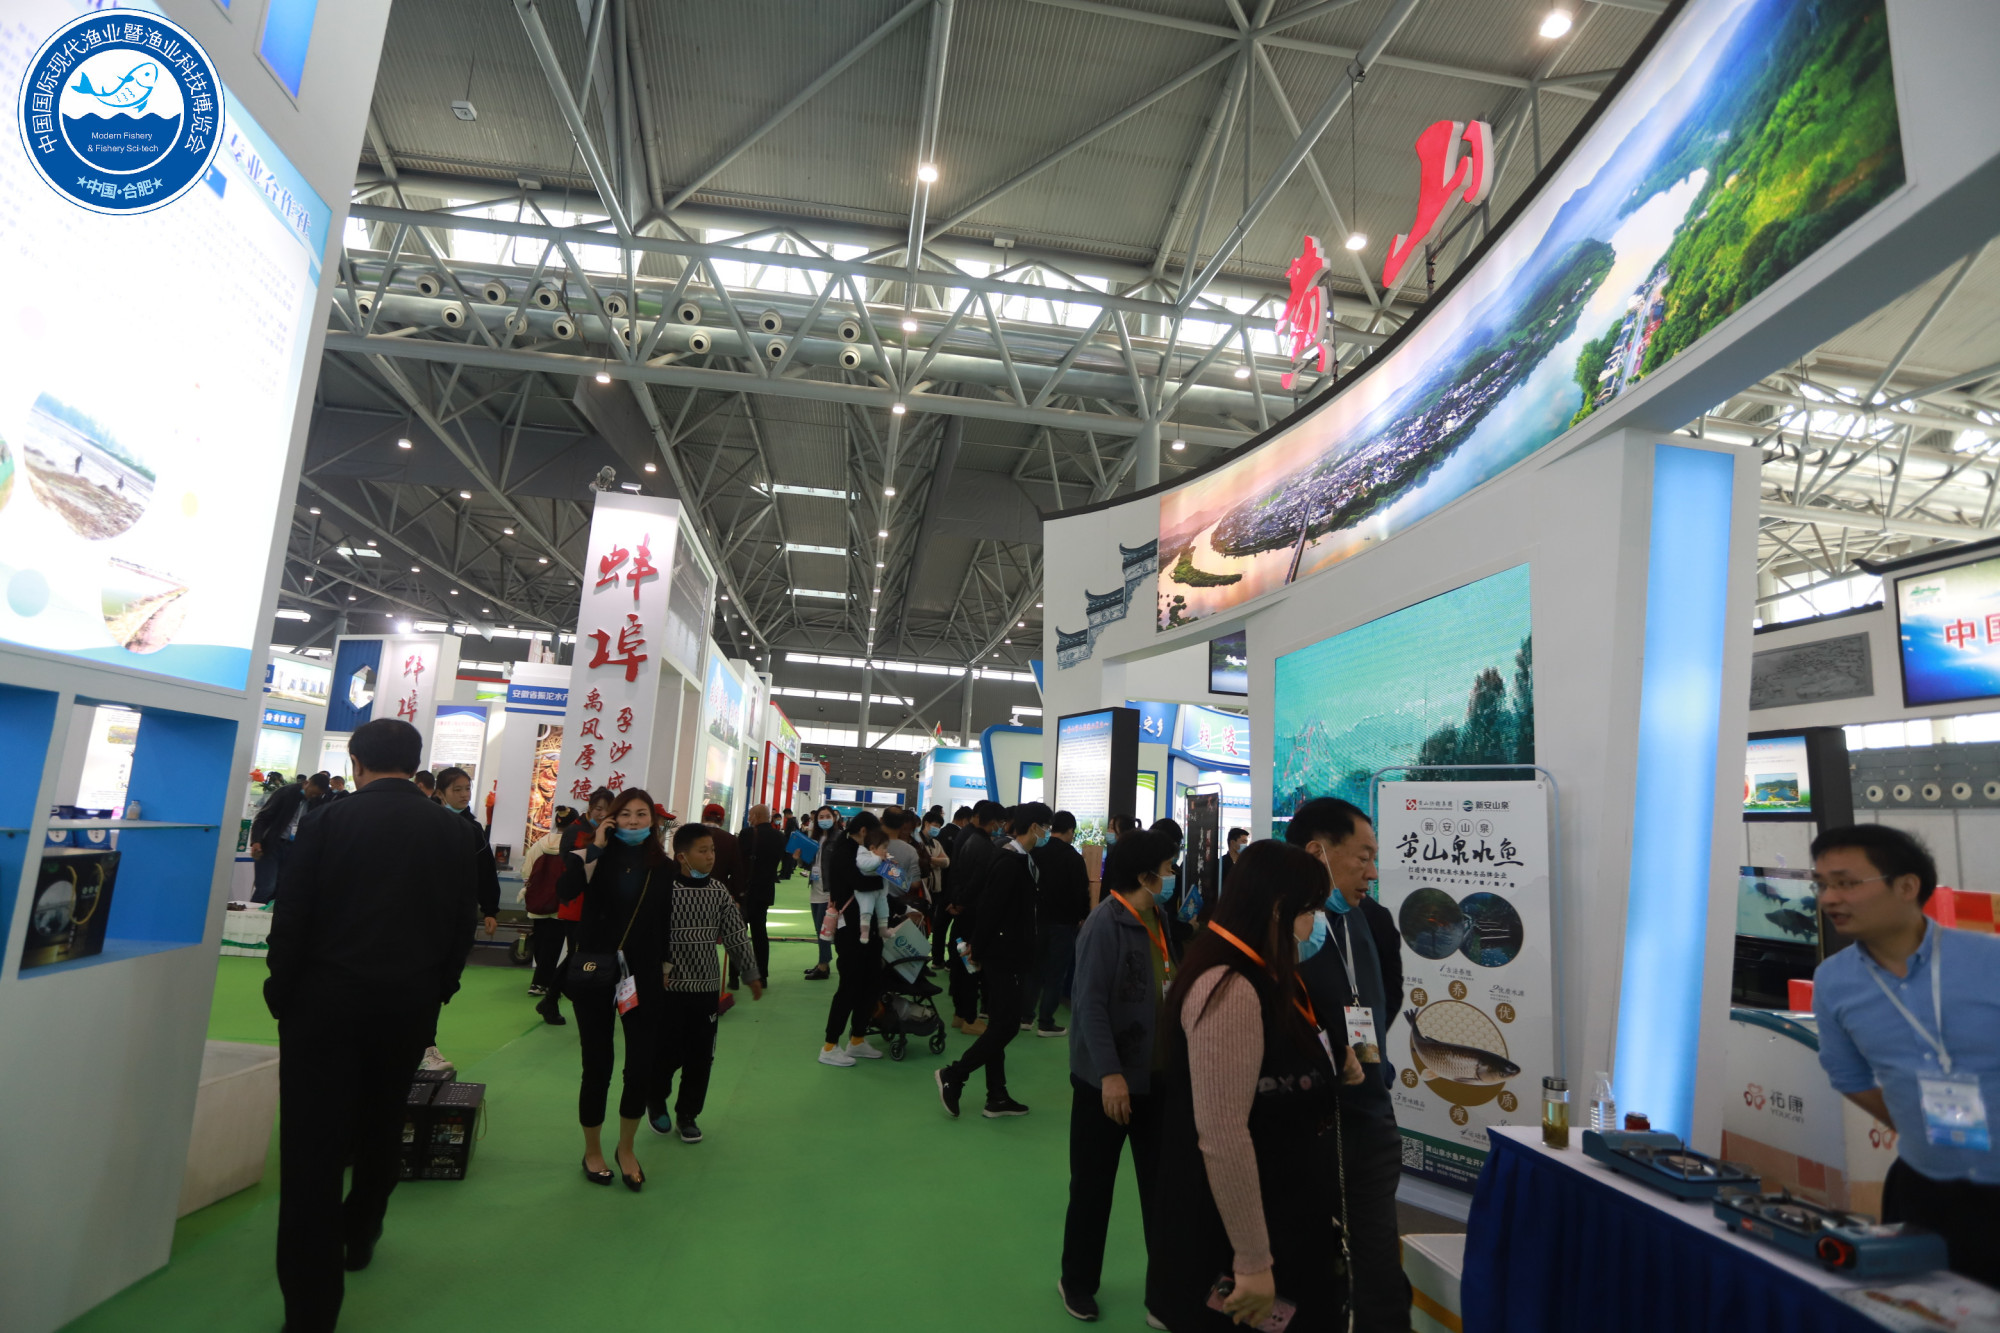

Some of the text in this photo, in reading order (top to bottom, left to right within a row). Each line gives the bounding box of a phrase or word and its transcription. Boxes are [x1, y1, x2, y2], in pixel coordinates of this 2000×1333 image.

[588, 533, 657, 682] 蚌埠
[397, 654, 425, 722] 蚌埠
[1139, 715, 1163, 738] 之乡
[1475, 801, 1509, 810] 新安山泉
[1424, 821, 1494, 833] 新安山泉
[1396, 832, 1524, 866] 黄山泉水鱼
[1452, 984, 1464, 998] 养
[1498, 1006, 1513, 1021] 优
[1403, 1071, 1416, 1084] 香
[1500, 1093, 1514, 1109] 质
[1452, 1109, 1465, 1123] 瘦
